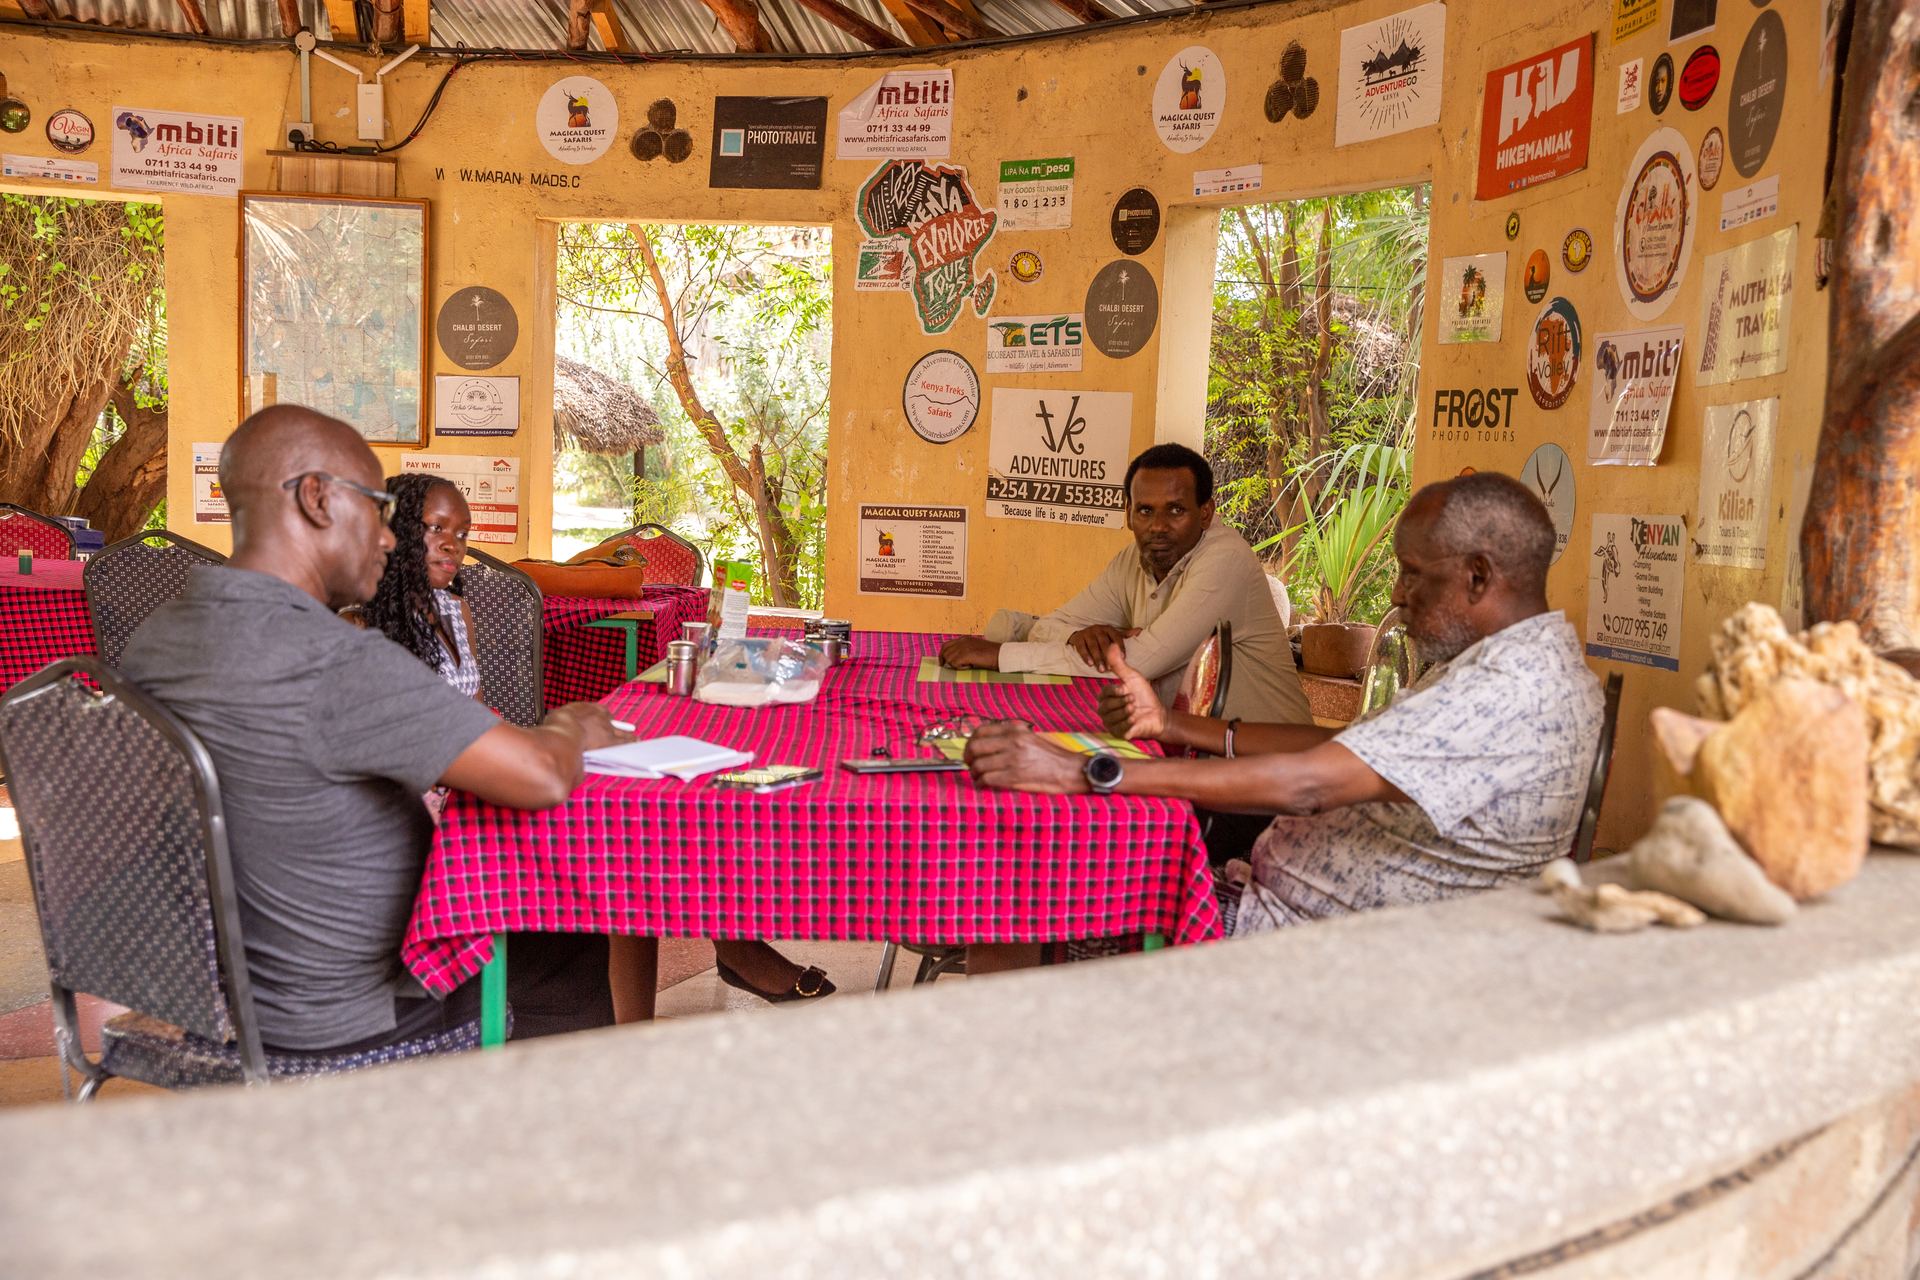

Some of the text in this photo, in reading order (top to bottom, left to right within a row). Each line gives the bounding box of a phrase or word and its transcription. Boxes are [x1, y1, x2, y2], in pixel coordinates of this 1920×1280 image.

[878, 80, 949, 105] mbiti
[1382, 93, 1399, 101] KENYA
[877, 106, 949, 119] Africa Safaris
[1193, 113, 1215, 121] QUEST
[156, 121, 237, 148] mbiti
[563, 136, 592, 144] SAFARIS
[583, 129, 606, 137] QUEST
[747, 130, 817, 145] PHOTOTRAVEL
[844, 134, 947, 143] www.mbitiafricasafaris.com
[157, 143, 238, 161] Africa Safaris
[1496, 128, 1573, 170] HIKEMANIAK
[145, 158, 218, 172] 0711 33 44 99
[1004, 168, 1017, 176] LIPA
[1018, 167, 1029, 175] NA
[120, 167, 236, 184] www.mbitiafricasafaris.com
[907, 177, 964, 234] KENYA
[917, 218, 989, 268] EXPLORER
[1099, 304, 1144, 313] CHALBI DESERT
[452, 324, 502, 332] CHALBI DESERT
[1030, 316, 1082, 345] ETS
[1537, 323, 1571, 357] Rift
[1018, 349, 1040, 358] TRAVEL
[1047, 348, 1071, 357] SAFARIS
[921, 380, 965, 396] Kenya Treks
[928, 406, 952, 418] Safaris
[1433, 388, 1519, 428] FROST
[1641, 409, 1650, 421] 44
[1432, 430, 1515, 442] PHOTO TOURS
[1009, 455, 1106, 480] ADVENTURES
[990, 481, 1124, 508] +254 727 553384
[1718, 489, 1754, 521] Kilian
[864, 508, 961, 518] MAGICAL QUEST SAFARIS
[1035, 506, 1046, 519] life
[1050, 508, 1056, 519] is
[1633, 522, 1680, 546] KENYAN
[1638, 548, 1678, 562] Adventures
[1612, 616, 1668, 641] 0727 995 749
